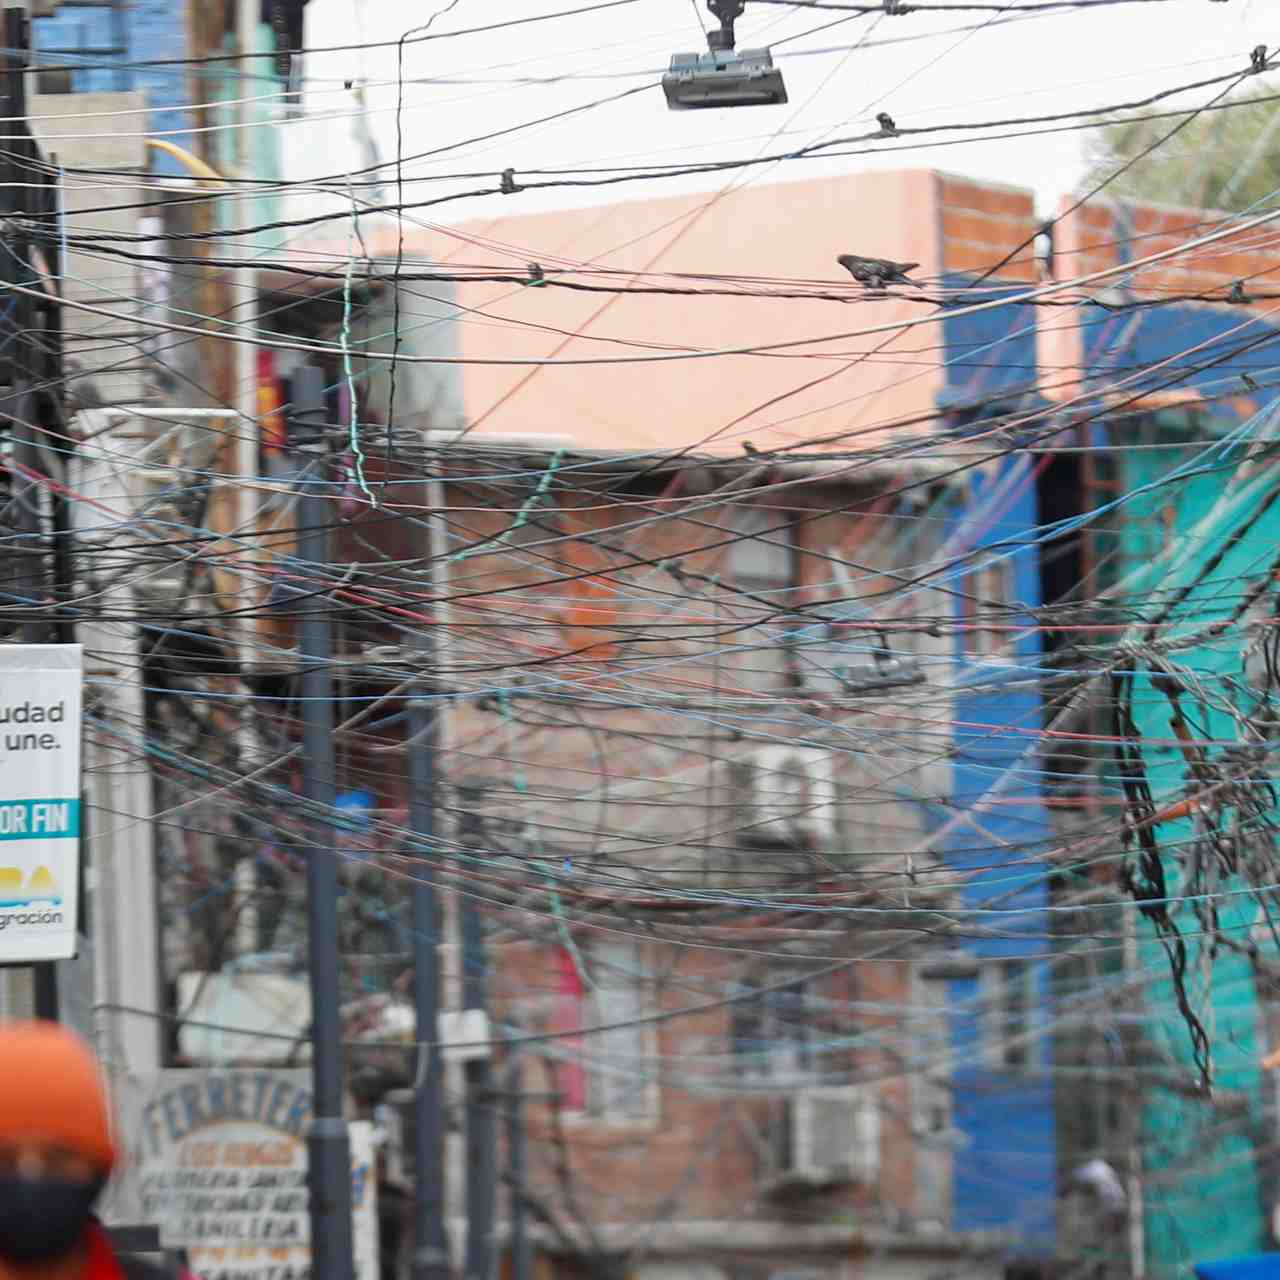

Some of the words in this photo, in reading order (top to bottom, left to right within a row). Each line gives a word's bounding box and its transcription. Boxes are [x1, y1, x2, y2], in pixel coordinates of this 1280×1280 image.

[6, 731, 61, 751] une.
[32, 803, 69, 833] FIN
[143, 1073, 311, 1157] FERRETER
